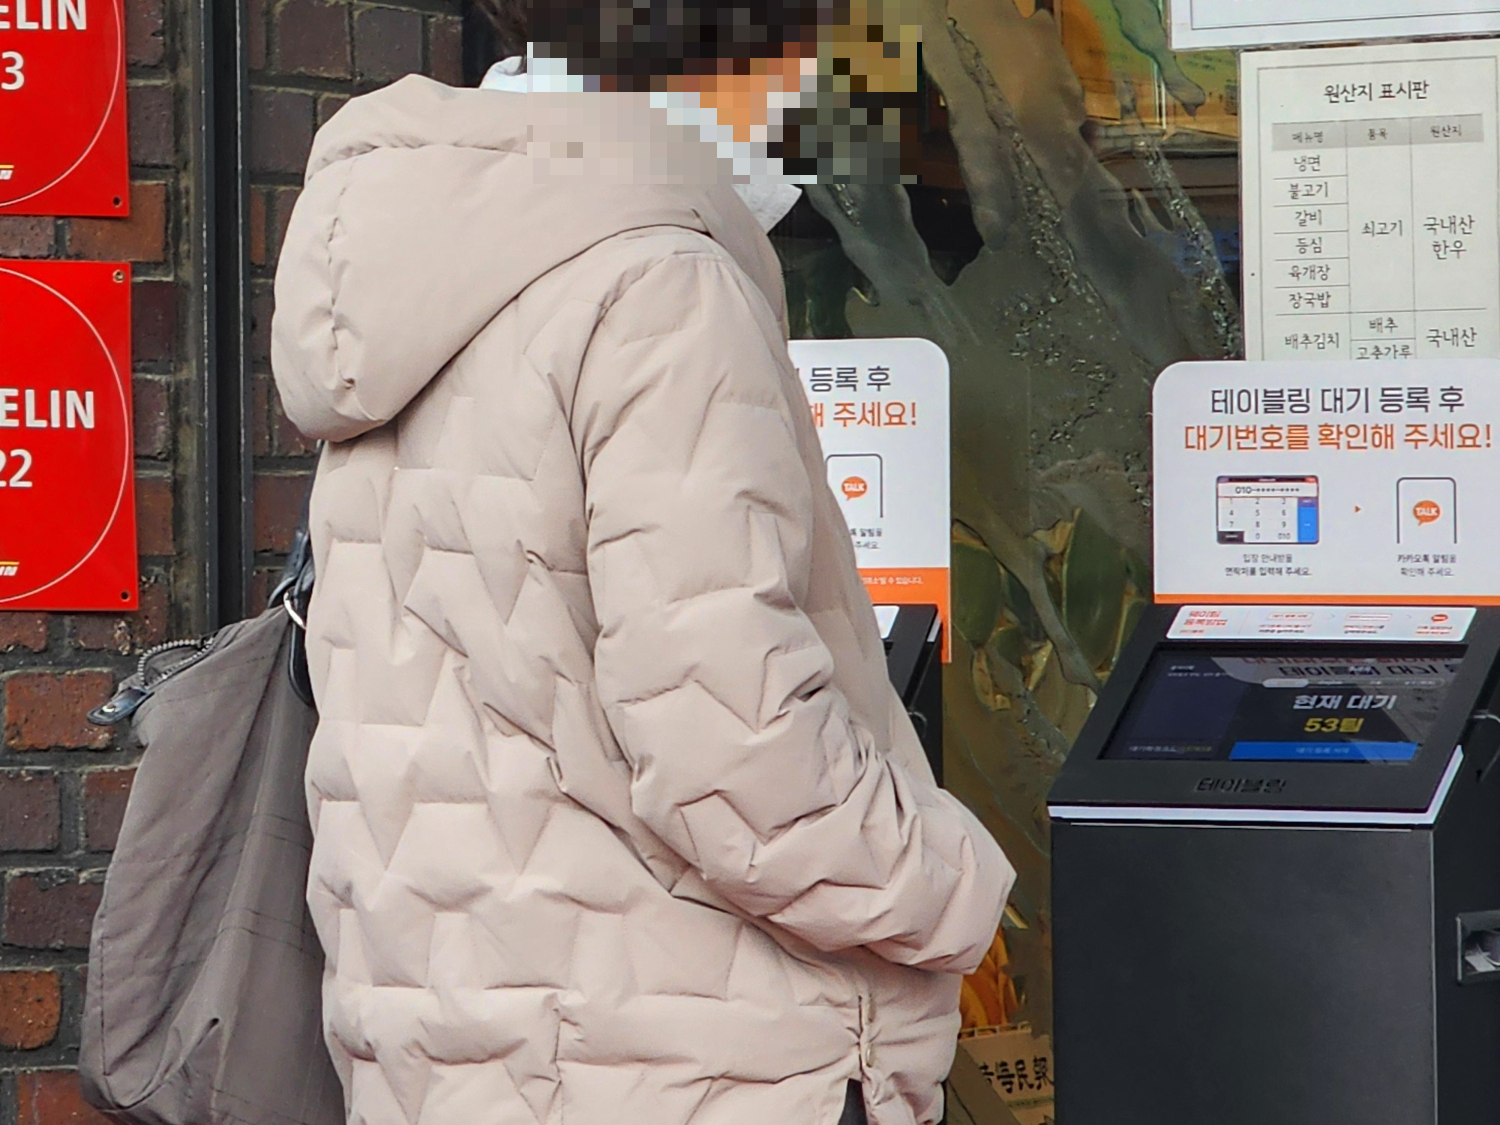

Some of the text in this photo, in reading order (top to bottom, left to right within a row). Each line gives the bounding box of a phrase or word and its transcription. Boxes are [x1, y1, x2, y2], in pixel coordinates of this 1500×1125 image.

[1324, 80, 1429, 104] 원산지 표시판
[1294, 154, 1321, 173] 냉면
[1288, 181, 1329, 199] 불고기
[1295, 209, 1322, 227] 갈비
[1423, 214, 1476, 236] 국내산
[1361, 219, 1404, 238] 쇠고기
[1296, 235, 1323, 255] 등심
[1432, 240, 1467, 261] 한우
[1289, 263, 1331, 282] 육개장
[1289, 291, 1331, 310] 장국밥
[1368, 316, 1398, 333] 배추
[1284, 331, 1340, 350] 배추김치
[1426, 327, 1478, 349] 국내산
[810, 365, 891, 392] 등록 후
[1211, 385, 1465, 415] 테이블링 대기 등록 후
[833, 401, 917, 427] 주세요!
[1184, 422, 1492, 451] 대기번호를 확인해 주세요!
[1293, 694, 1397, 710] 현재 대기
